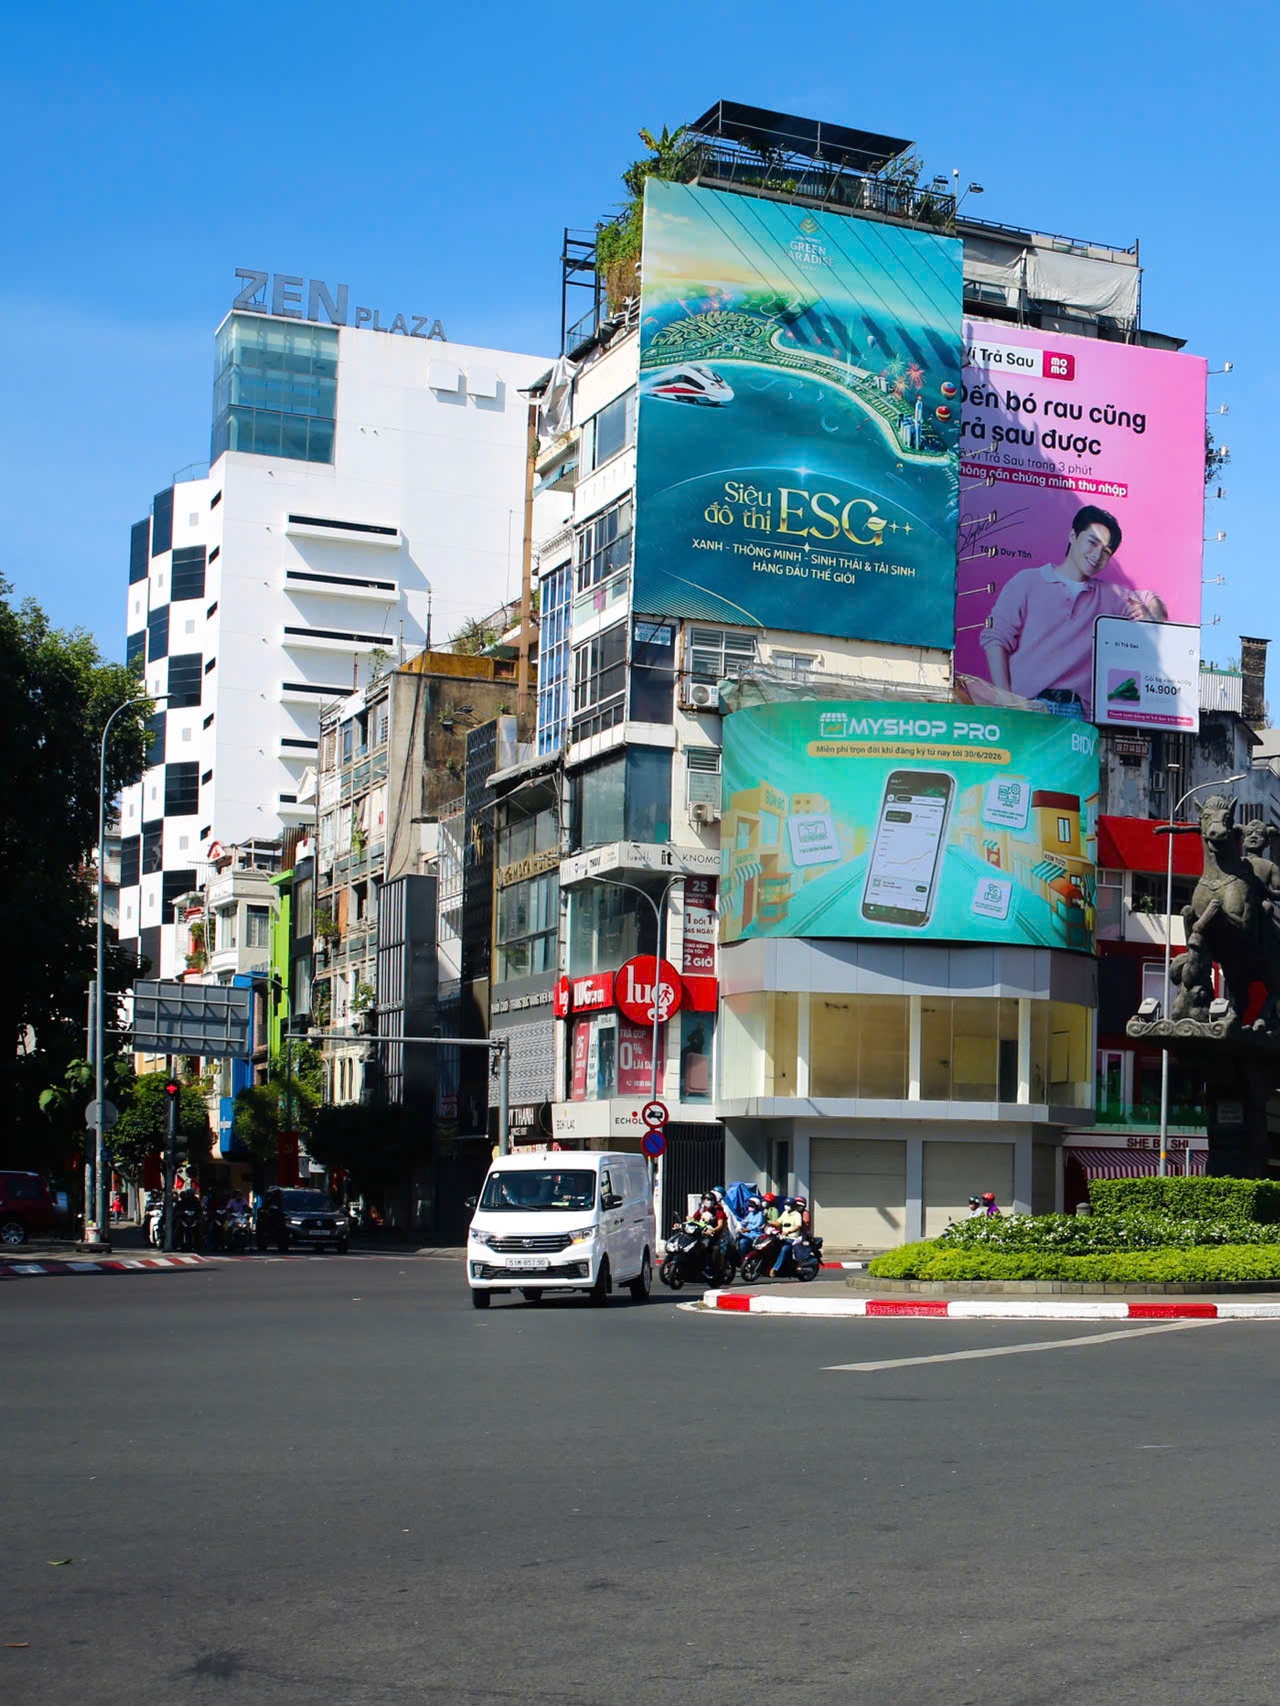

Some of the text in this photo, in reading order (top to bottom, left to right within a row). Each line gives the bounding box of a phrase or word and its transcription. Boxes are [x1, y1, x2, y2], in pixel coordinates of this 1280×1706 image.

[790, 240, 826, 256] GREEN
[785, 249, 834, 267] ARADISE
[233, 268, 447, 342] ZEN PLAZA
[1006, 353, 1034, 368] Sau
[1006, 391, 1037, 413] bó
[1043, 400, 1082, 420] rau
[1089, 404, 1146, 434] cũng
[961, 417, 1101, 458] rả sau được
[1003, 454, 1024, 466] Sau
[1028, 458, 1055, 472] trong
[1058, 462, 1065, 472] 3
[1068, 463, 1092, 476] phút
[1012, 470, 1046, 486] chứng
[1048, 475, 1076, 489] minh
[1078, 480, 1096, 491] thu
[1098, 482, 1127, 497] nhập
[724, 481, 771, 507] Siêu
[743, 507, 771, 534] thị
[692, 538, 915, 577] XANH THÔNG MINH SINH THÁI & TÁI SINH
[1001, 548, 1016, 558] Duy
[753, 560, 855, 584] HÀNG ĐẦU THẾ GIỚI
[850, 718, 1000, 741] MYSHOP PRO
[816, 745, 836, 754] Miễn
[850, 746, 866, 755] trọn
[881, 746, 894, 754] khi
[937, 750, 950, 758] nay
[965, 750, 1002, 760] 30/6/2026
[661, 850, 673, 865] it
[692, 881, 708, 891] 25
[686, 913, 692, 924] 1
[707, 914, 713, 925] 1
[696, 927, 714, 935] NGÀY
[684, 955, 713, 968] 2 GIỜ
[626, 965, 674, 1022] lug
[615, 1117, 645, 1125] ECHOL
[1127, 1138, 1149, 1149] SHE
[1171, 1139, 1189, 1149] SHI
